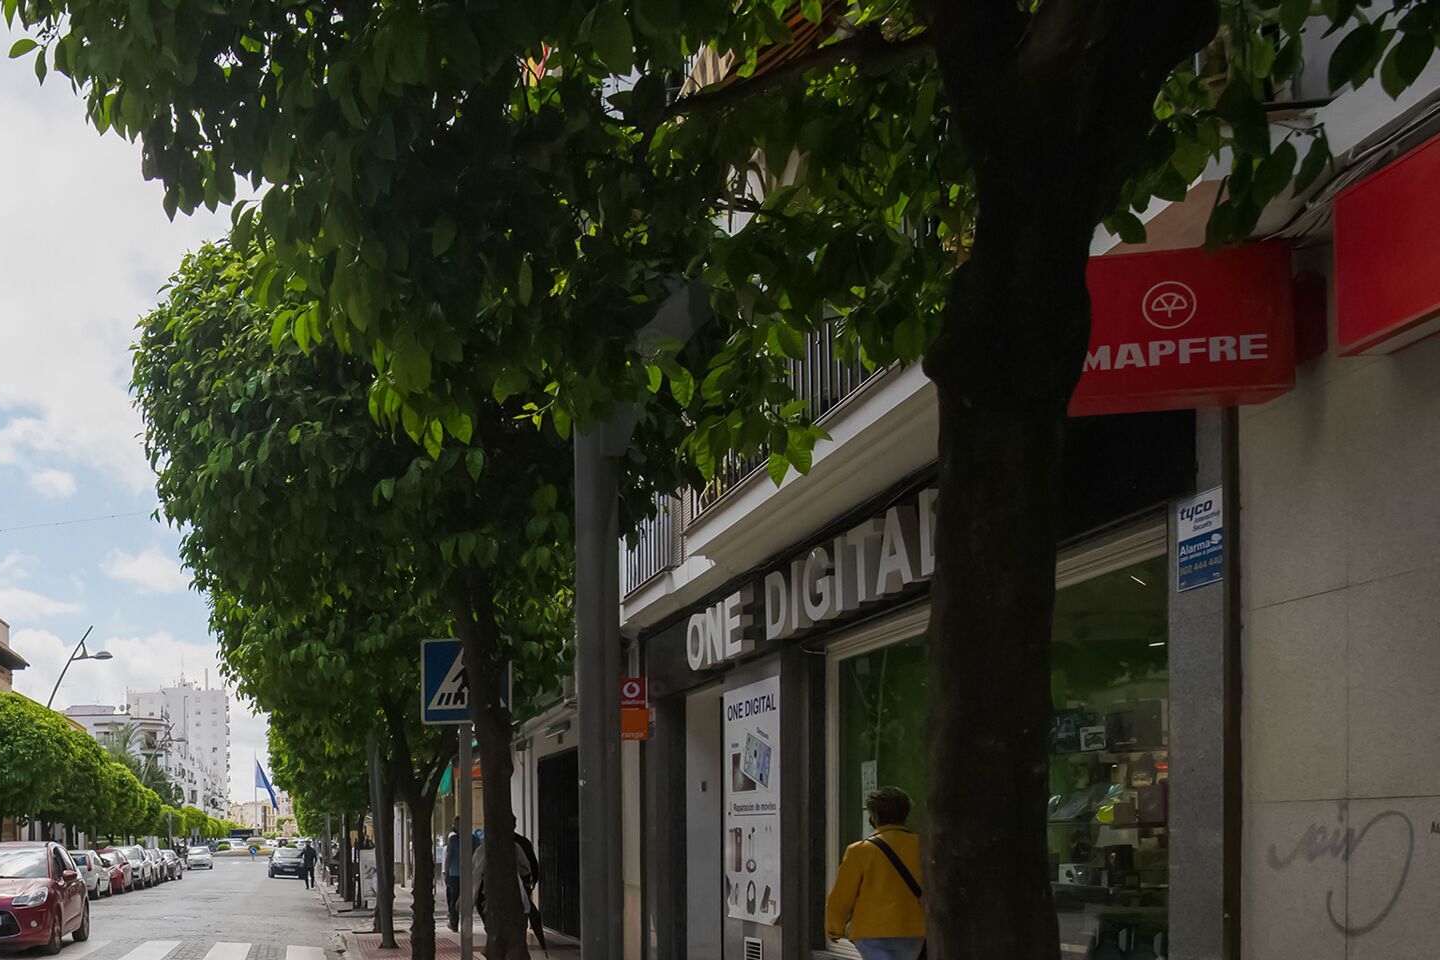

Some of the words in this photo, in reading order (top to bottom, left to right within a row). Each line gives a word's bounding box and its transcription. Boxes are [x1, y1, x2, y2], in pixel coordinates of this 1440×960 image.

[1082, 334, 1268, 372] MAPFRE
[1179, 500, 1213, 521] tyco
[1192, 521, 1213, 532] Security
[1180, 540, 1211, 556] Alarma
[687, 590, 750, 671] ONE
[727, 702, 743, 721] ONE
[745, 694, 776, 717] DIGITAL
